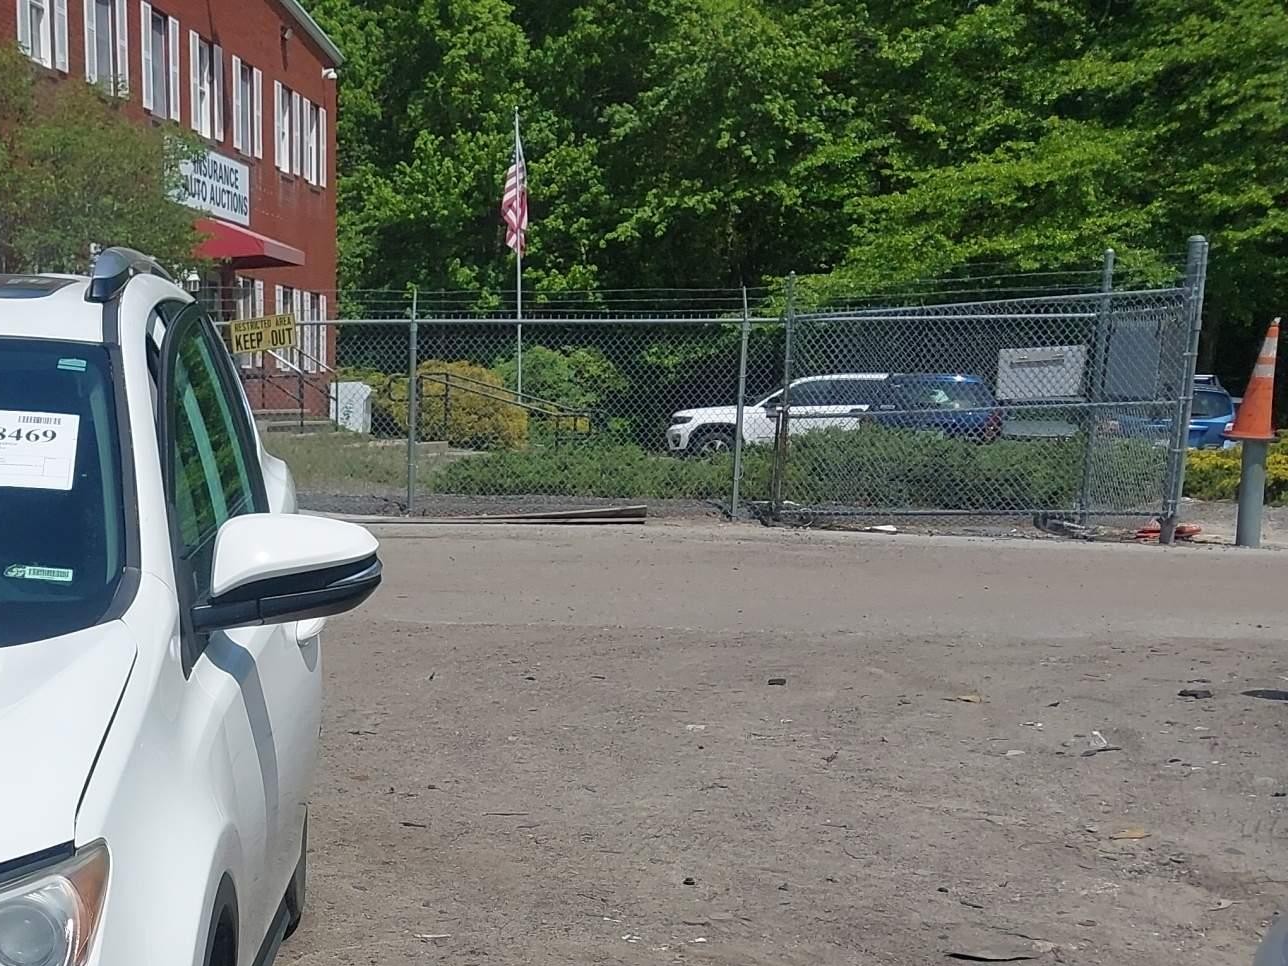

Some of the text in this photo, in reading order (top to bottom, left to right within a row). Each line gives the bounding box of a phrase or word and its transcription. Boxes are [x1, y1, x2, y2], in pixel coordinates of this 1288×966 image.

[193, 158, 239, 190] INSURANCE
[184, 174, 248, 216] AUTO AUCTIONS
[234, 316, 292, 333] RESTRICTED AREA
[235, 327, 293, 351] KEEP OUT
